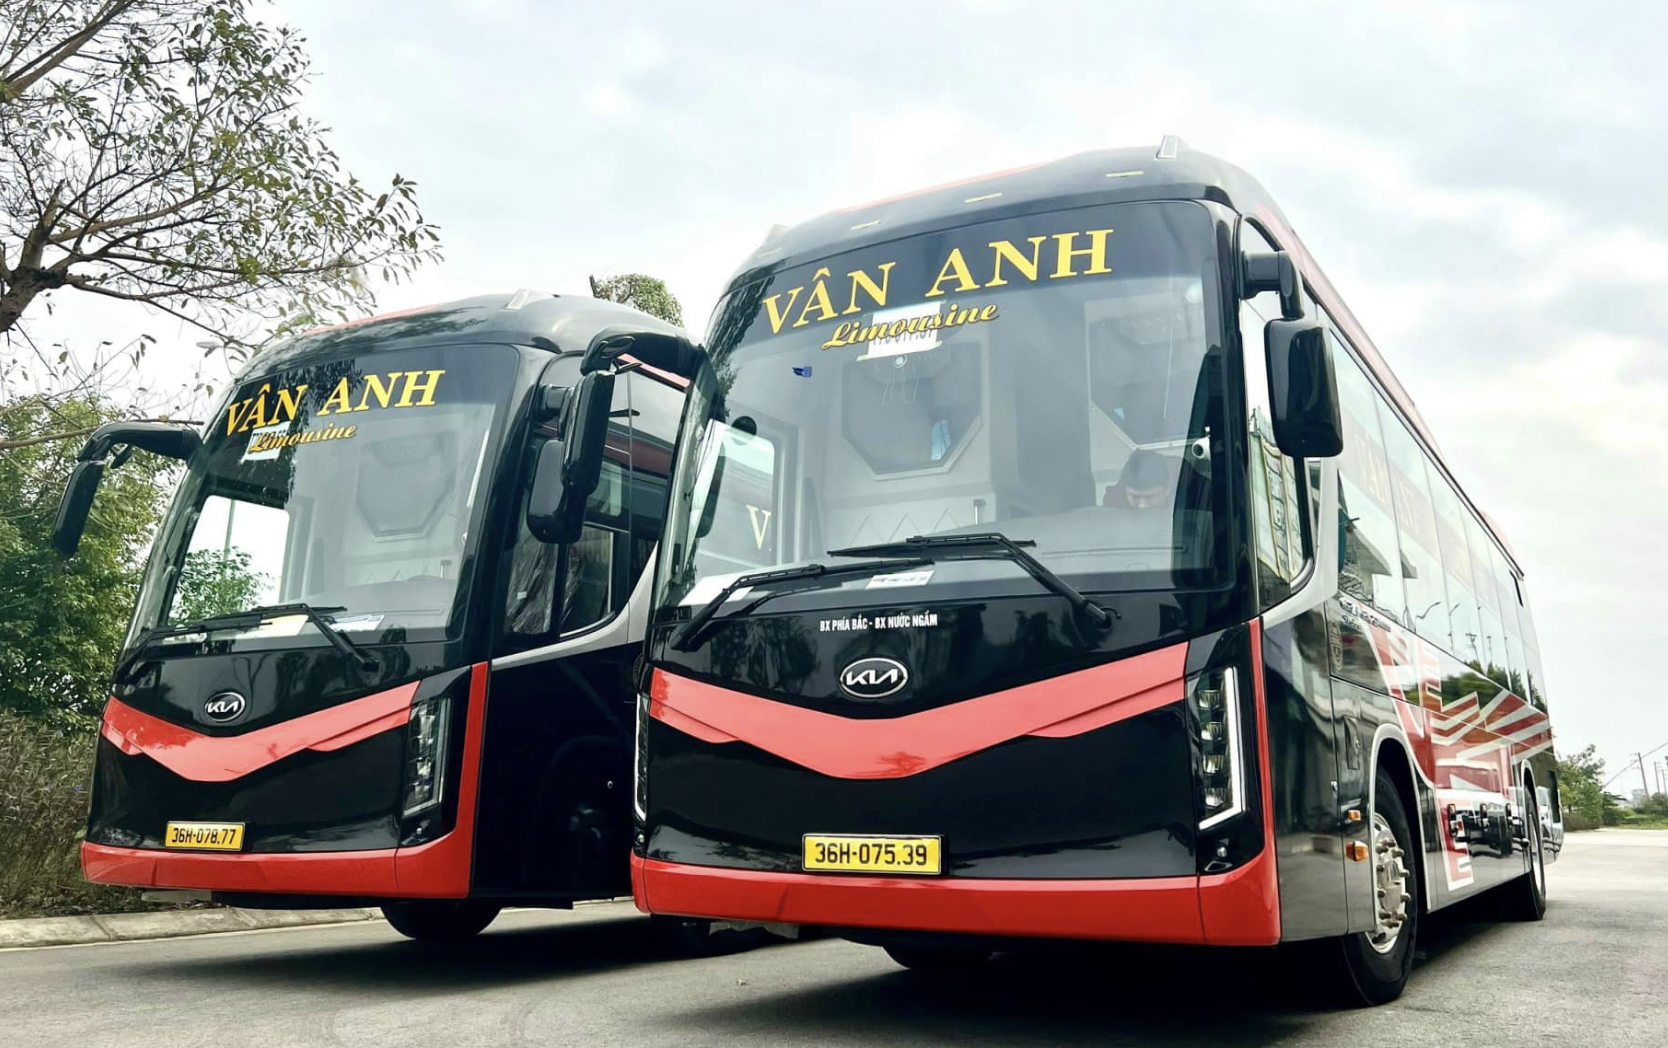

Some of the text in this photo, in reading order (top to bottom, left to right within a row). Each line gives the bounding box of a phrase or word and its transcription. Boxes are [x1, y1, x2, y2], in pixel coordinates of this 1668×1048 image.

[762, 262, 896, 335] VÂN
[925, 229, 1114, 298] ANH
[821, 301, 999, 350] Limousine
[227, 369, 446, 437] VÂN ANH
[247, 422, 357, 455] Limousine
[820, 619, 831, 632] BX
[831, 616, 850, 631] PHÍA
[851, 613, 868, 630] BẮC
[875, 616, 886, 629] BX
[887, 611, 910, 629] NƯỚC
[845, 668, 898, 686] KIA
[207, 700, 239, 714] KIA
[171, 826, 236, 845] 36H-078.77
[814, 842, 928, 866] 36H-075.39
